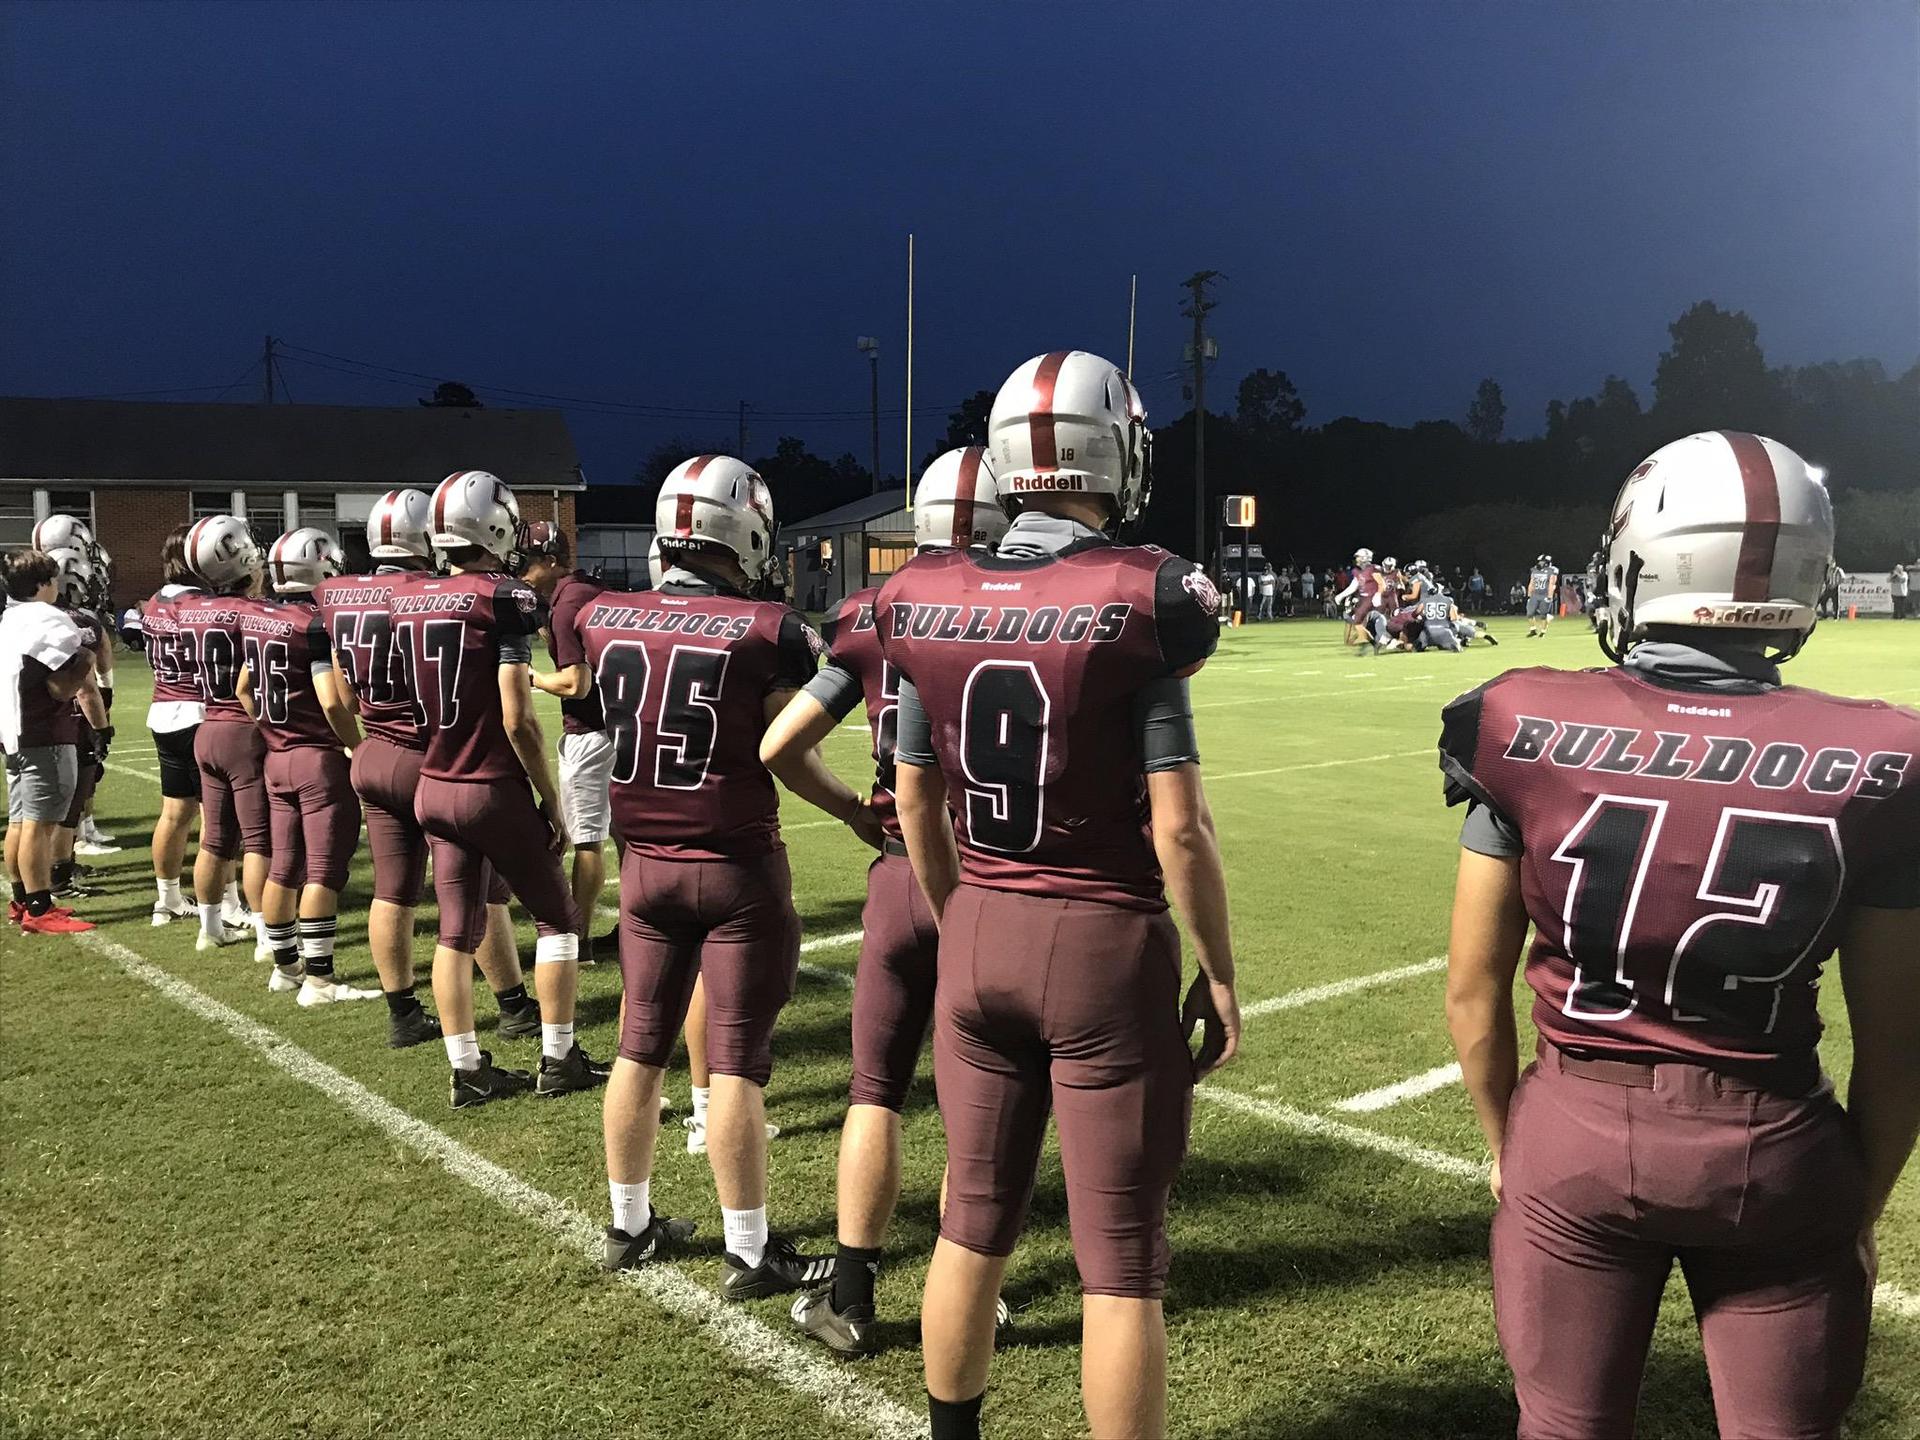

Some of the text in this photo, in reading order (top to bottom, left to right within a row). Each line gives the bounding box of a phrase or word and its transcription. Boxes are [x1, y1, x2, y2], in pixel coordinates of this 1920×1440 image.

[1060, 448, 1074, 462] 18
[1013, 475, 1083, 490] Riddell
[323, 586, 393, 607] BULLDOG
[981, 582, 1021, 591] Riddell
[586, 605, 755, 640] BULLDOGS
[891, 602, 1133, 644] BULLDOGS
[1425, 602, 1448, 620] 55
[332, 610, 394, 704] 57
[397, 619, 465, 729] 17
[596, 639, 732, 790] 85
[1667, 703, 1731, 718] Riddell
[960, 659, 1051, 852] 9
[1503, 714, 1913, 800] BULLDOGS
[1550, 794, 1846, 1035] 12
